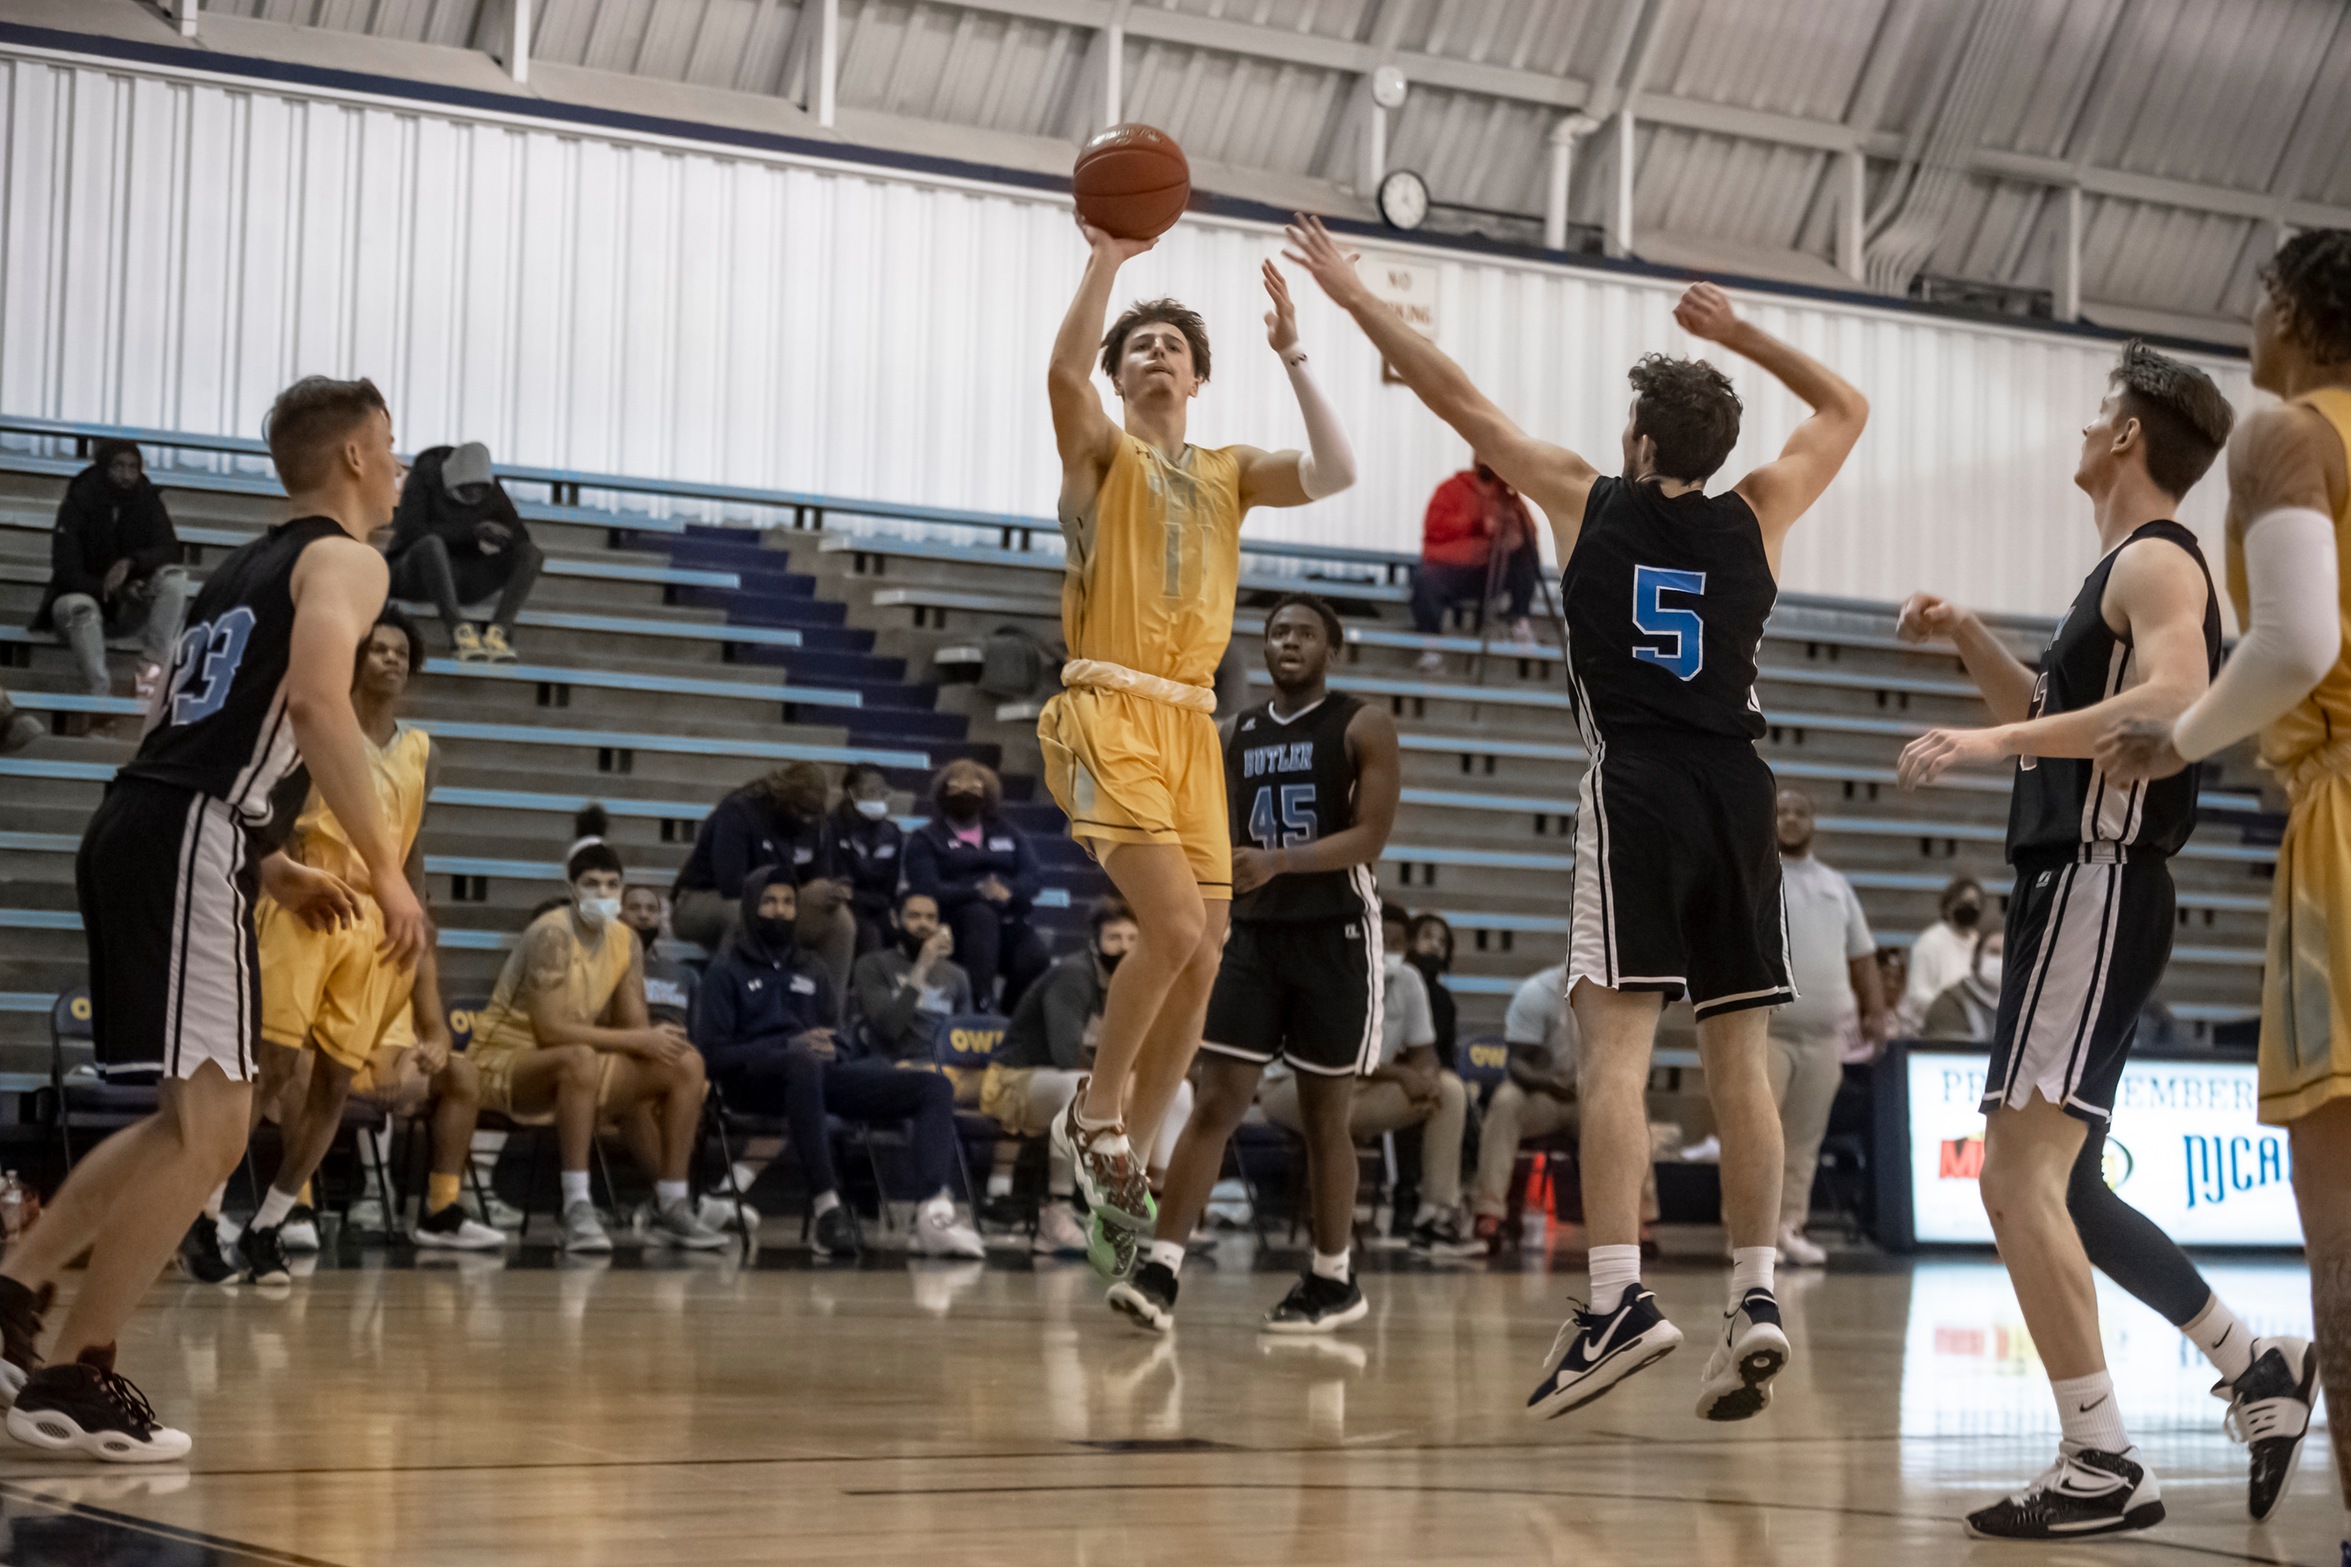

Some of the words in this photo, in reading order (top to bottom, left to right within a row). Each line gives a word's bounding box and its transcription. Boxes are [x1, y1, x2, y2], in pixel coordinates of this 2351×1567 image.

[1632, 564, 1707, 681] 5
[163, 605, 257, 727] 23
[1243, 741, 1314, 779] BUTLER
[1248, 783, 1318, 851] 45
[1469, 1045, 1507, 1068] OW
[2123, 1076, 2254, 1110] EMBER
[2183, 1132, 2293, 1210] NJCA
